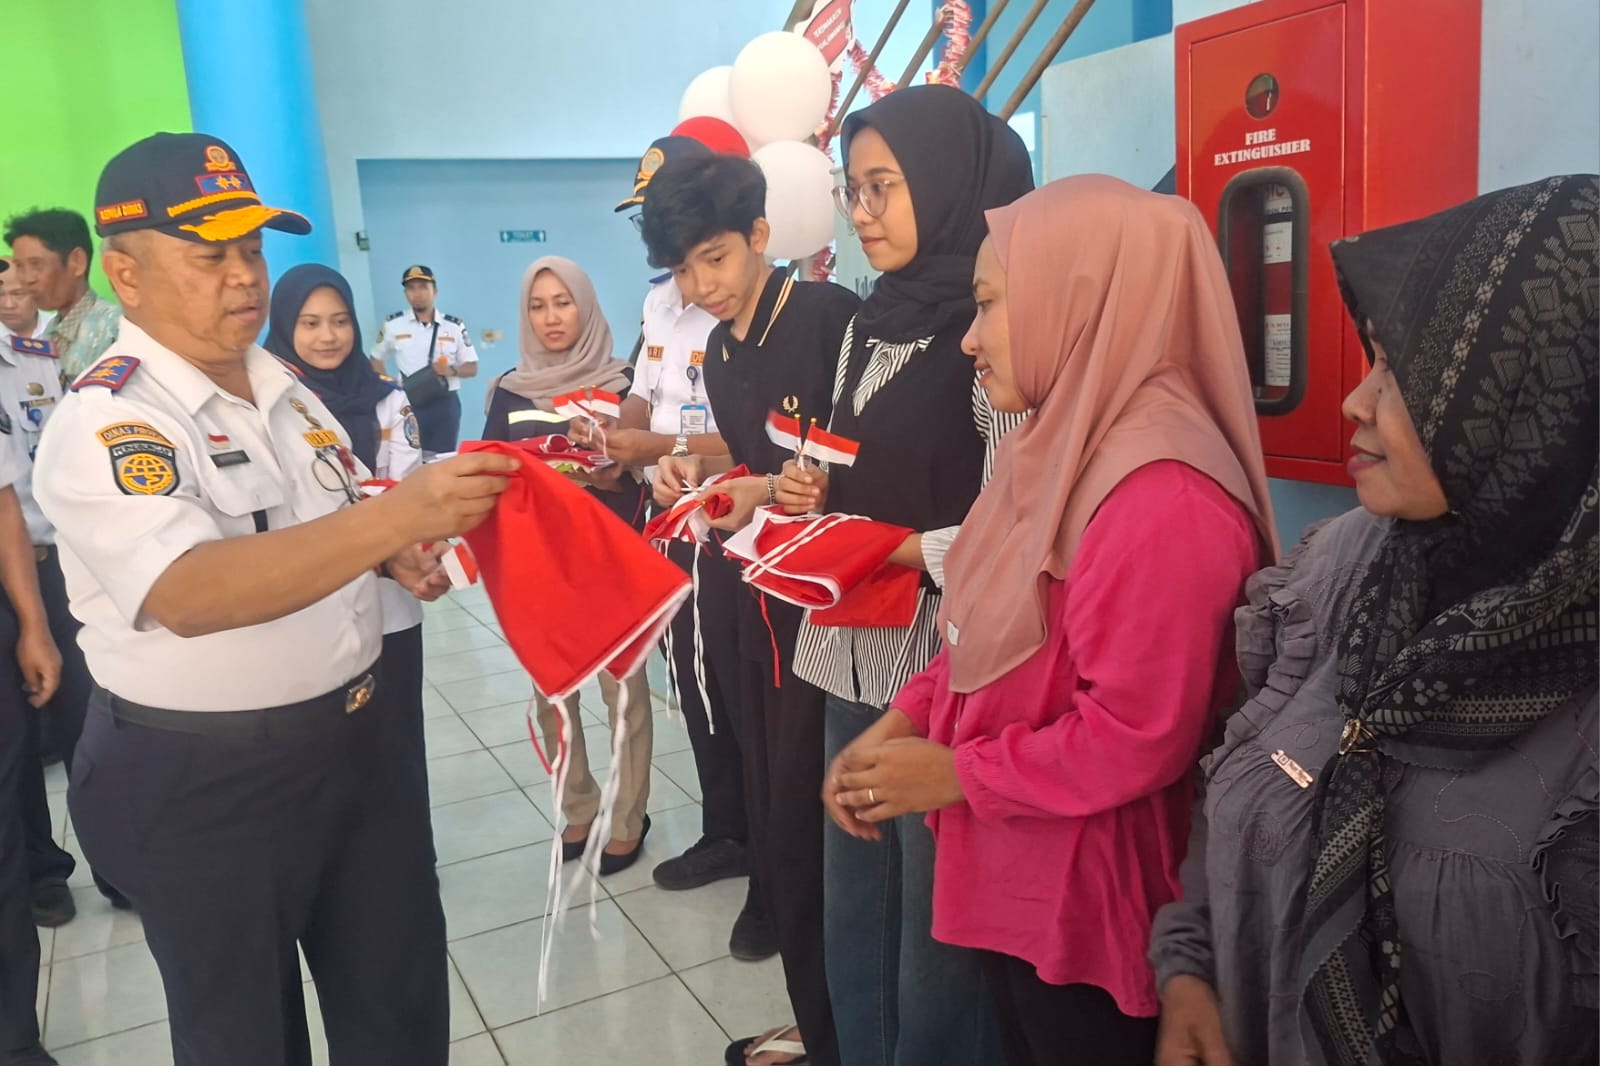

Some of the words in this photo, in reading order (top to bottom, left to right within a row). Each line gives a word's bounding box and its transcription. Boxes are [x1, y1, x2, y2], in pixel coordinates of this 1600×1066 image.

[1245, 128, 1276, 145] FIRE
[1214, 138, 1311, 166] EXTINGUISHER
[102, 426, 133, 441] DINAS
